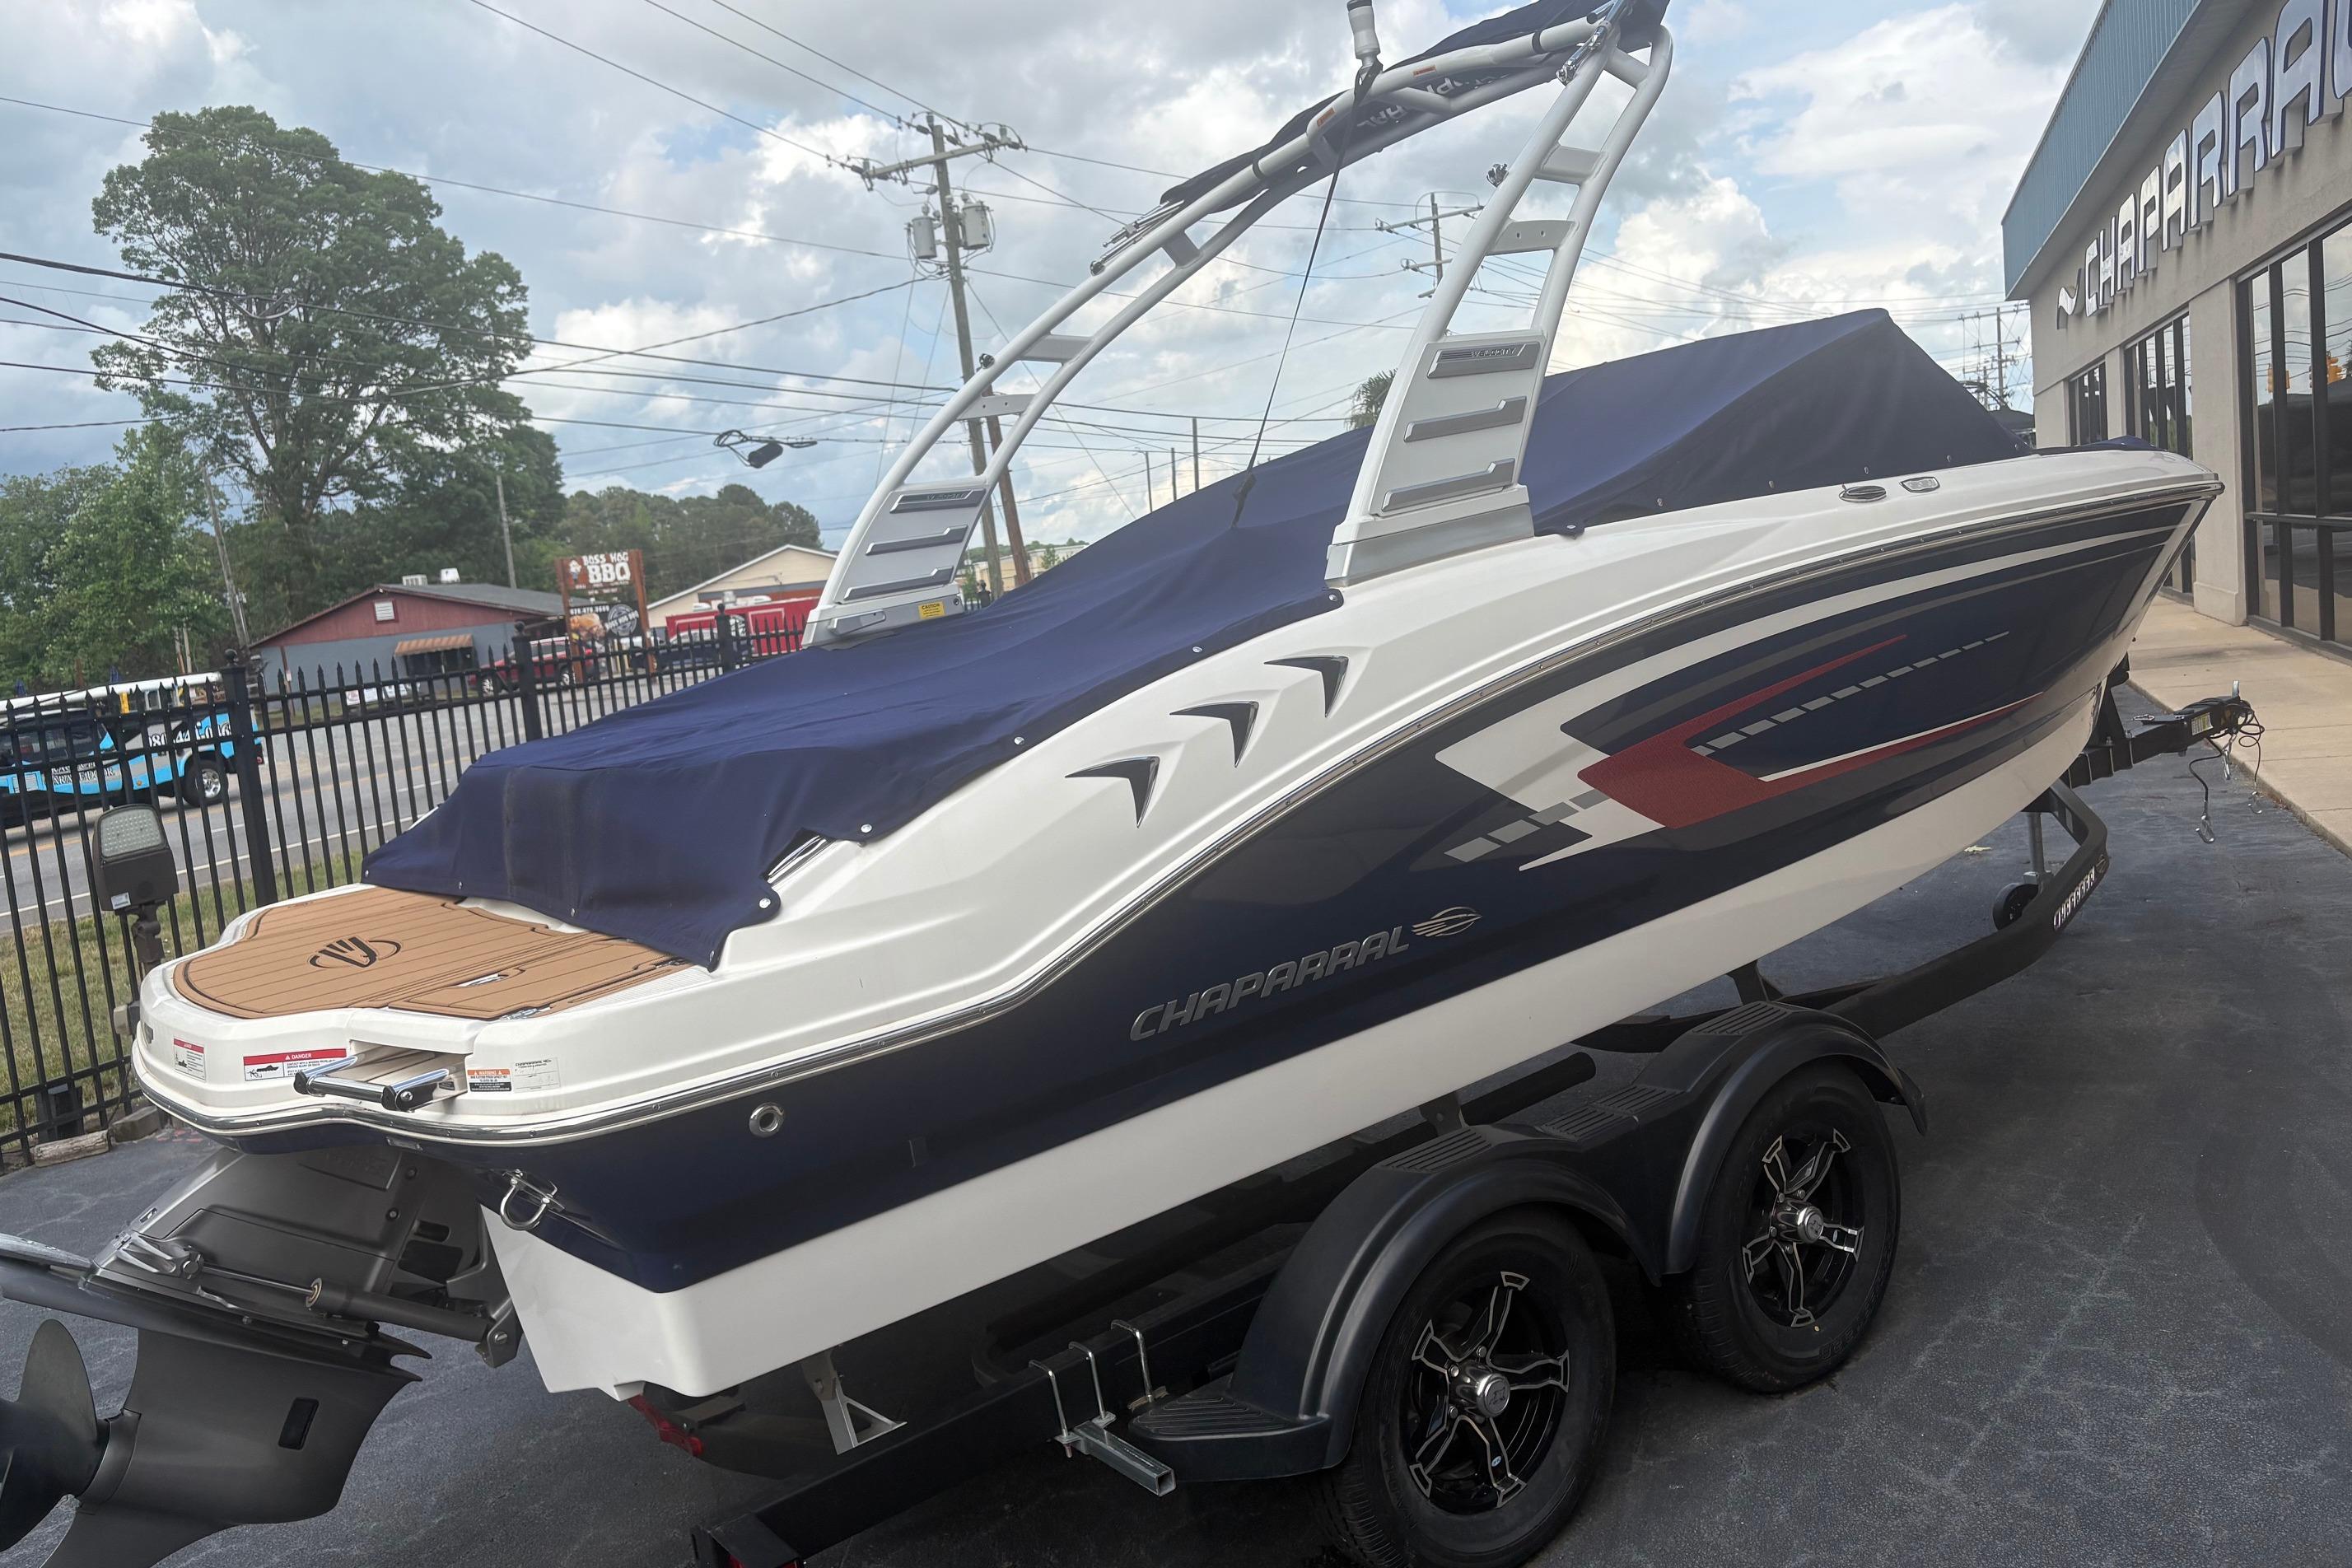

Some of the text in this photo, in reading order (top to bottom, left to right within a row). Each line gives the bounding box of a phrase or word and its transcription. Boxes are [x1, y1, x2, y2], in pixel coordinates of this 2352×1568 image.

[582, 552, 628, 566] BOSS HOG
[587, 562, 631, 583] BBQ
[1130, 926, 1409, 1041] CHAPARRAL
